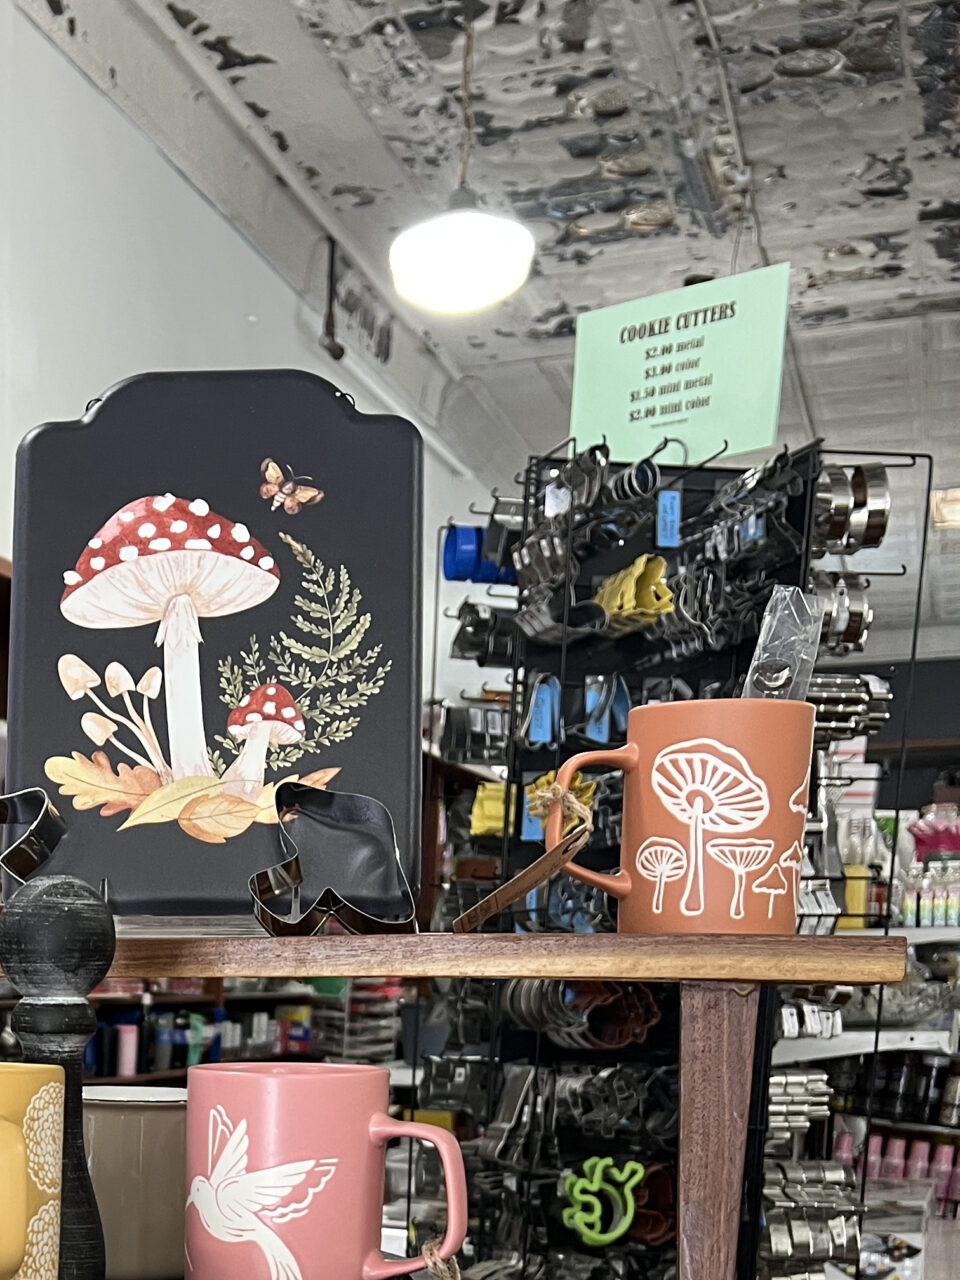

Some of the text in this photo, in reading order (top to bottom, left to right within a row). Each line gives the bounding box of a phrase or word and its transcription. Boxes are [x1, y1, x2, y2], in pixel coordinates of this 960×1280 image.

[619, 300, 737, 344] COOKIE CUTTERS
[645, 336, 705, 361] $2.00 metal
[658, 380, 682, 396] mini
[684, 373, 714, 391] metal
[628, 405, 657, 423] $2.00
[659, 399, 683, 416] mini
